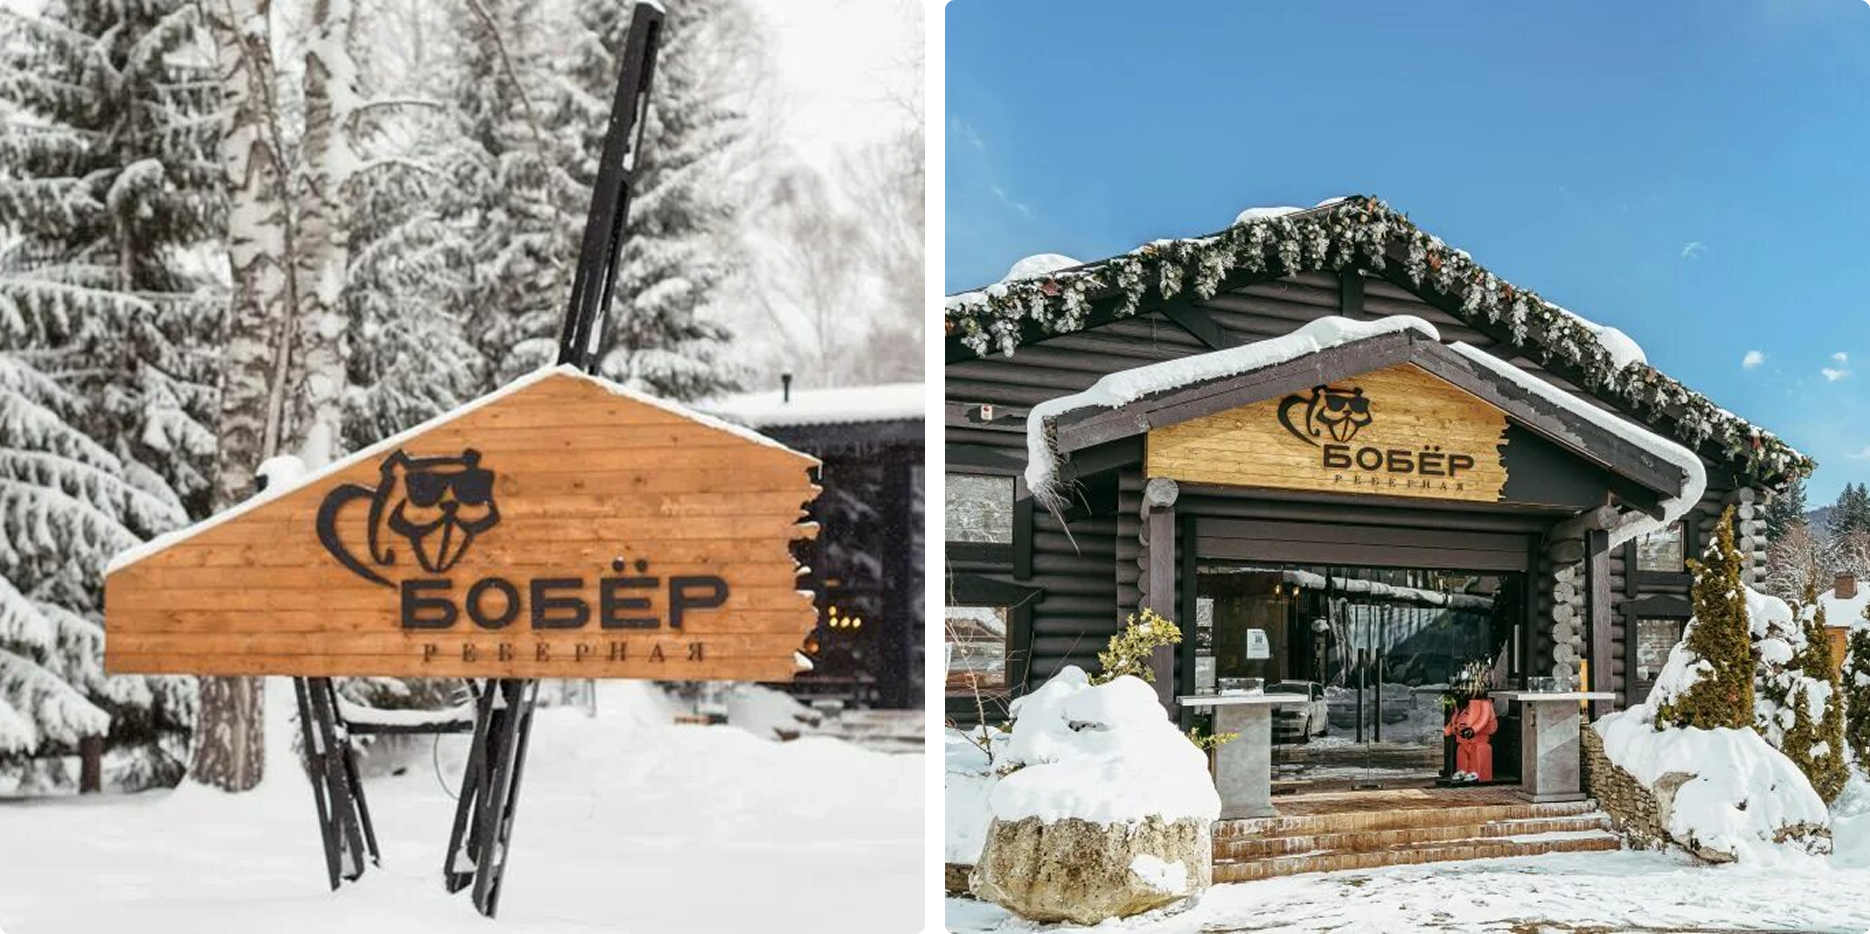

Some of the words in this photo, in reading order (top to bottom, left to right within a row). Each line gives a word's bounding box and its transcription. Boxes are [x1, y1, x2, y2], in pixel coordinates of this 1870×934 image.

[1323, 443, 1475, 477] БОБЁР
[1334, 473, 1463, 491] РЕБЕРНАЯ
[401, 558, 730, 630] БОБЁР
[422, 641, 703, 663] РЕБЕРНАЯ
